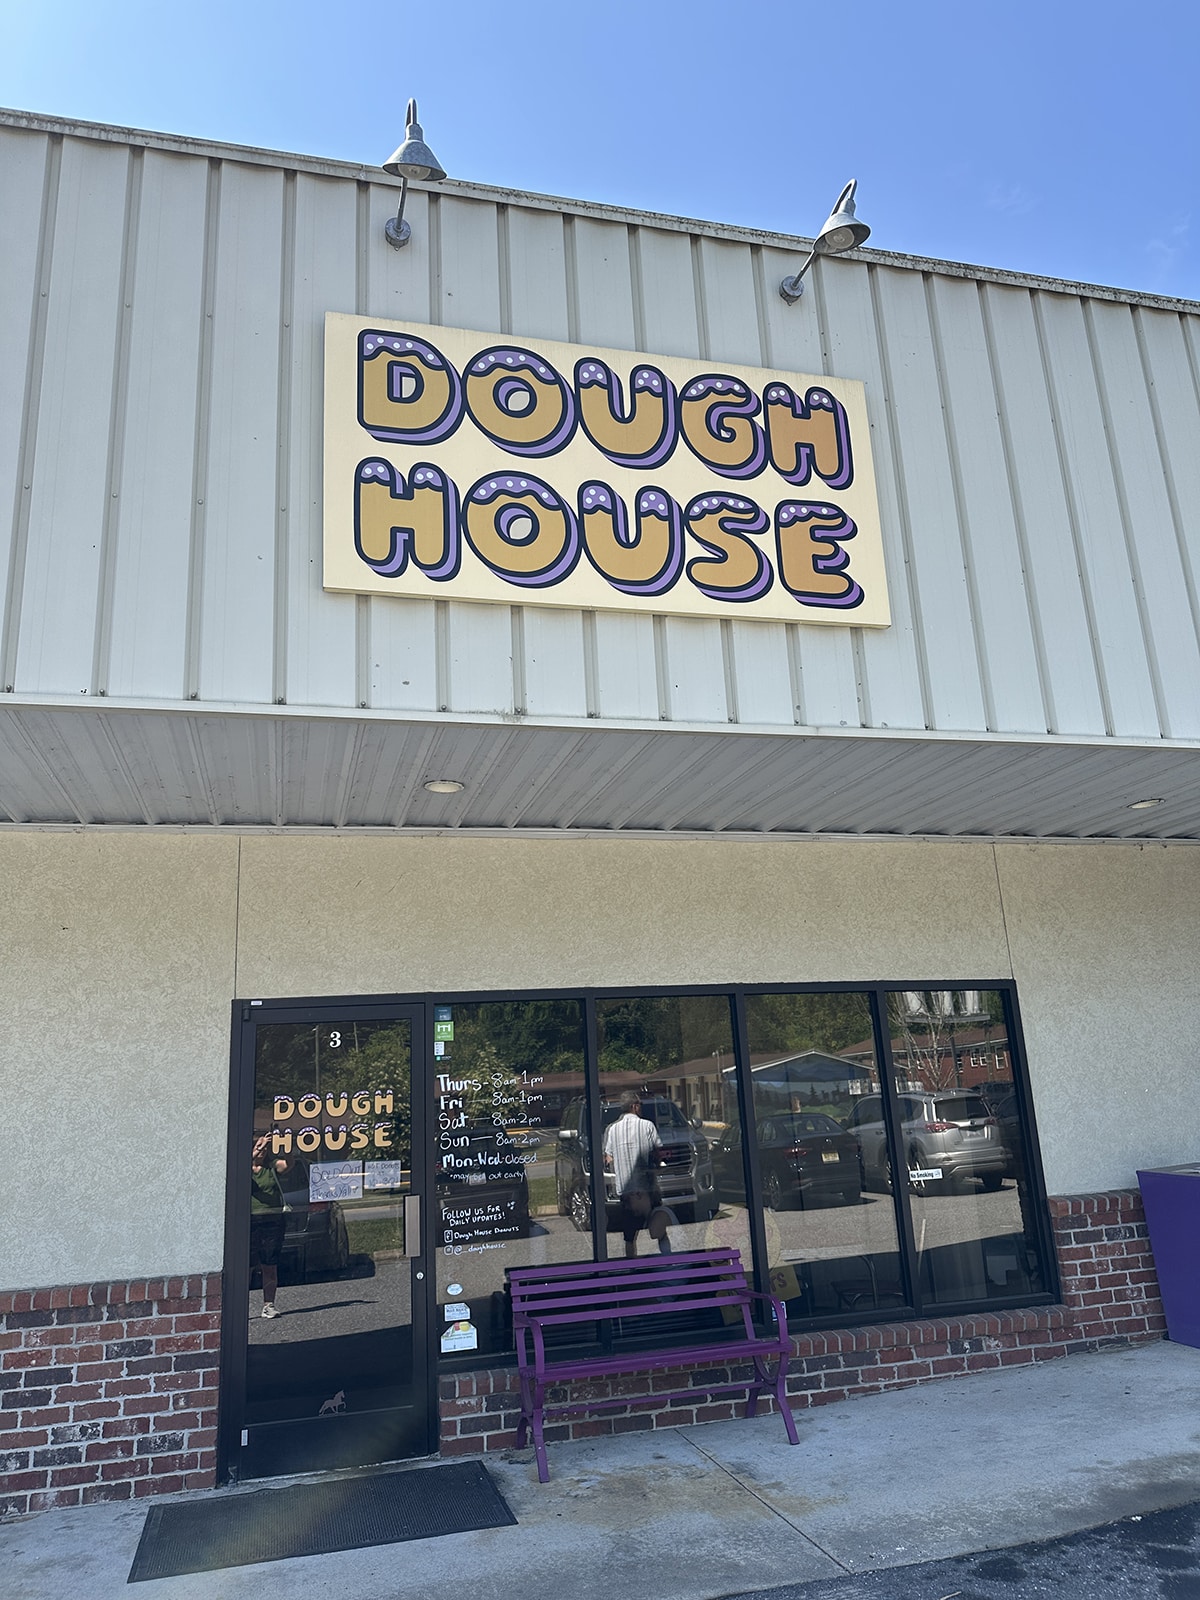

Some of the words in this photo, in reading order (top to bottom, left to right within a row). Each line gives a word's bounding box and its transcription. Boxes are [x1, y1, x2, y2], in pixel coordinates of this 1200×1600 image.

[357, 329, 854, 490] DOUGH
[354, 457, 865, 609] HOUSE
[329, 1031, 342, 1048] 3
[273, 1089, 394, 1121] DOUGH
[440, 1095, 463, 1110] Fri
[438, 1112, 469, 1130] Sat
[272, 1121, 393, 1155] HOUSE
[440, 1131, 470, 1150] Sun
[489, 1171, 502, 1180] out
[917, 1171, 934, 1179] Smoking
